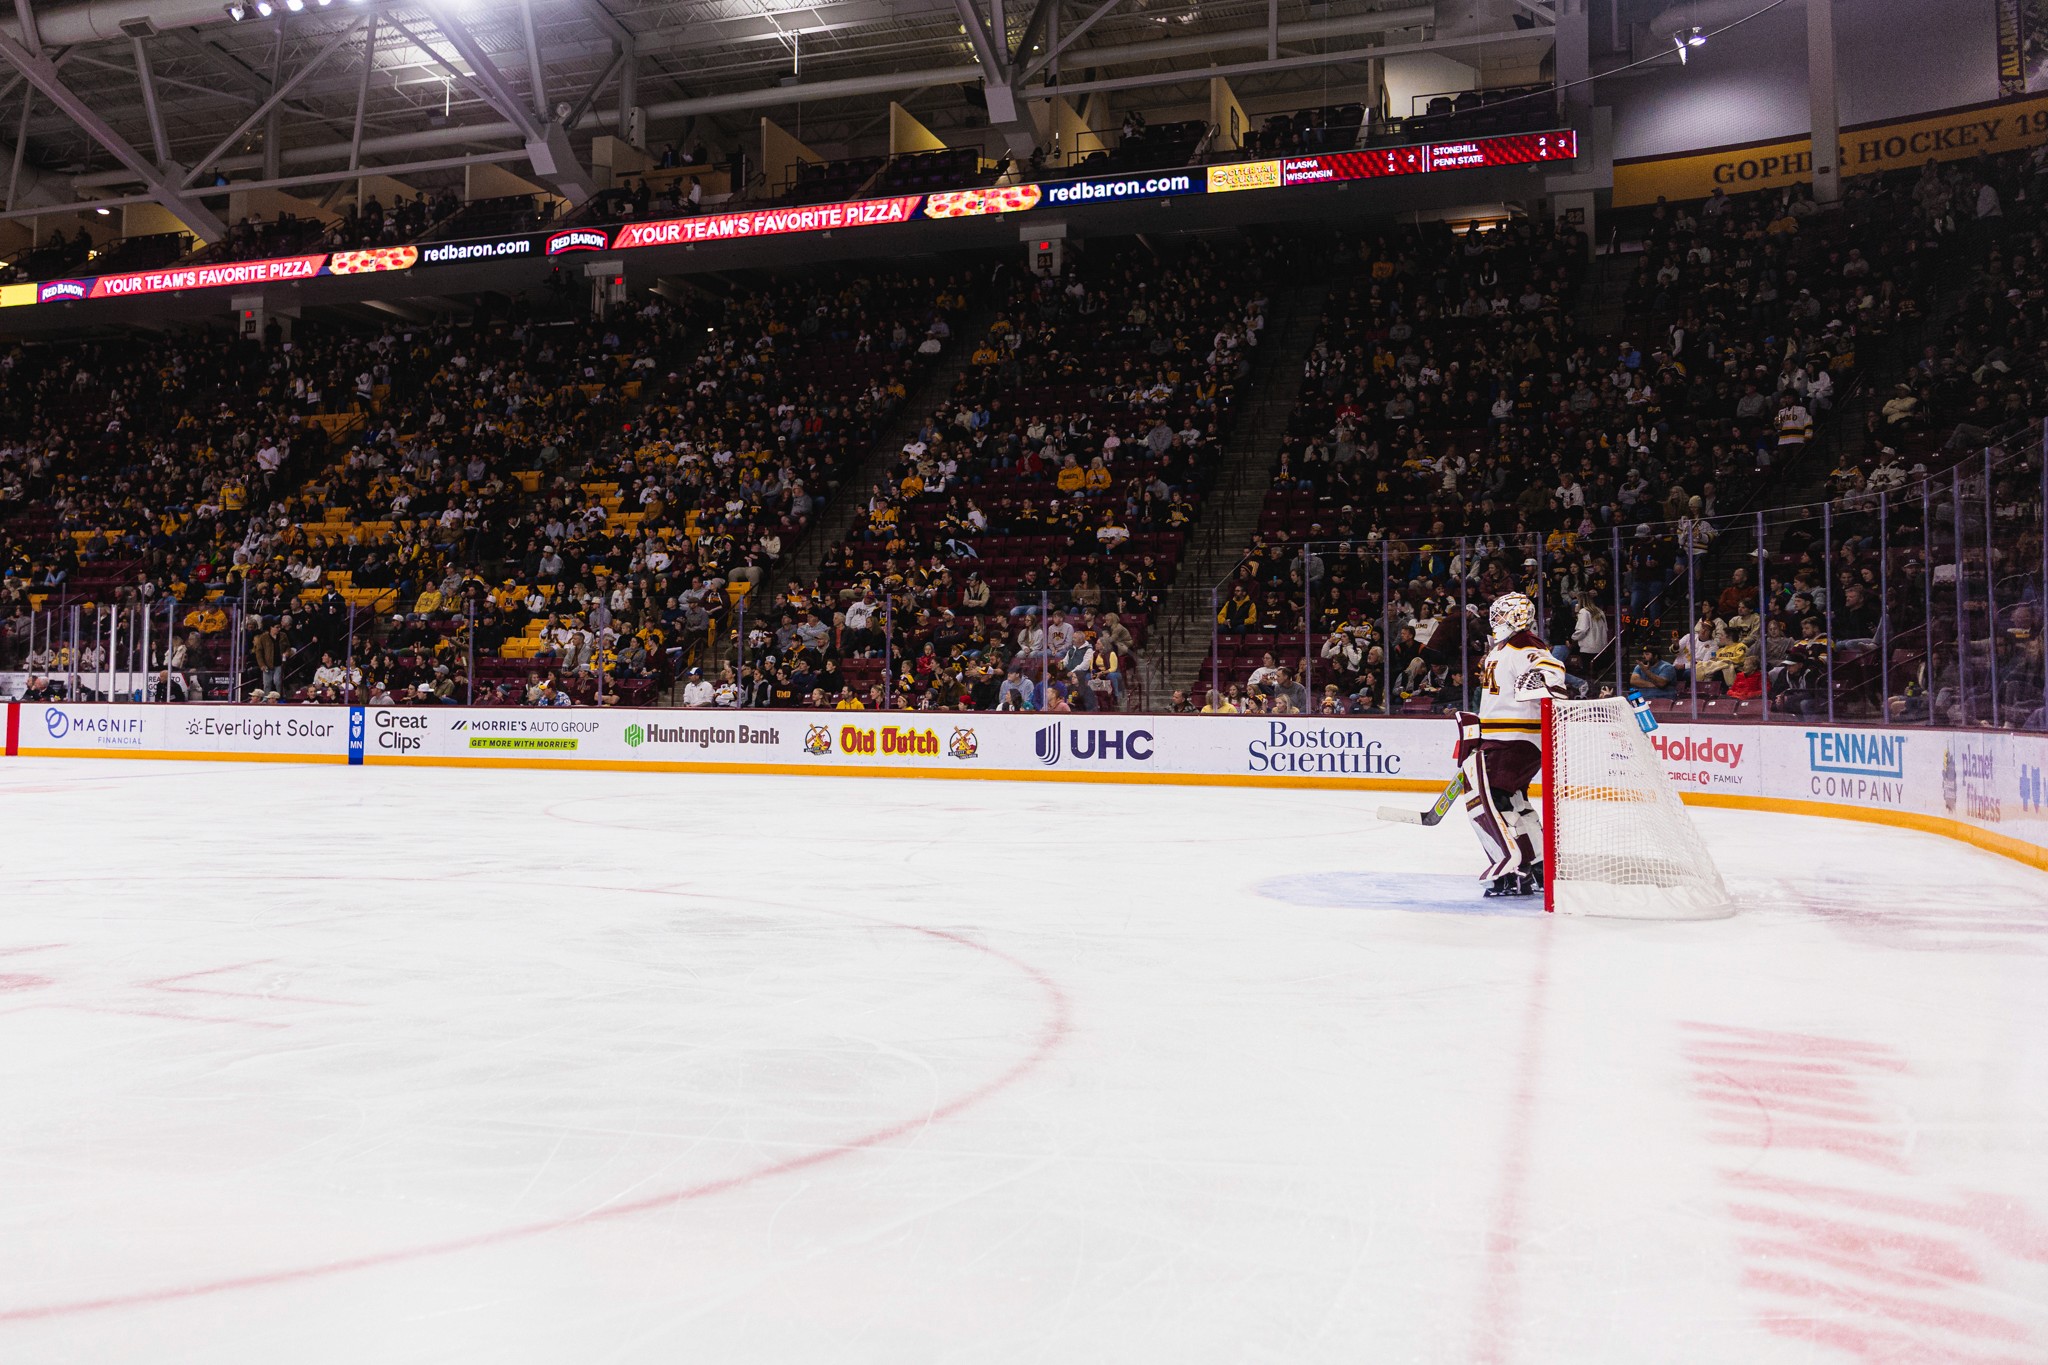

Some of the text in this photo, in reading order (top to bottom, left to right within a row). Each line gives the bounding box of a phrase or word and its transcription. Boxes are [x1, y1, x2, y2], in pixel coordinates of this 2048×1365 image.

[1433, 137, 1565, 155] STONEHILL 2 3
[1857, 117, 2004, 164] HOCKEY
[1286, 152, 1415, 170] ALASKA 1 2
[1433, 149, 1546, 167] PENN STATE 4
[1286, 164, 1395, 180] WISCONSIN 1
[1049, 175, 1190, 202] redbaron.com
[631, 203, 903, 245] YOUR TEAM'S FAVORITE PIZZA
[424, 240, 530, 262] redbaron.com
[551, 233, 605, 252] RED BARON
[1038, 256, 1052, 266] 21
[104, 261, 313, 294] YOUR TEAM'S FAVORITE PIZZA
[42, 283, 84, 300] RED BARON
[776, 689, 791, 698] UMD
[73, 718, 143, 733] MAGNIFI
[204, 718, 334, 740] Everlight Solar
[375, 710, 428, 729] Great
[472, 720, 600, 733] MORRIE'S AUTO GROUP
[97, 737, 142, 745] FINANCIAL
[350, 740, 363, 749] MN
[378, 731, 421, 754] Clips
[472, 739, 576, 749] GET MORE WITH MORRIE'S
[647, 723, 780, 749] Huntington Bank
[841, 725, 939, 755] Old Dutch
[1070, 729, 1154, 760] UHC
[1268, 721, 1365, 750] Boston
[1248, 739, 1401, 775] Scientific
[1650, 735, 1744, 768] Holiday
[1805, 731, 1905, 768] TENNANT
[1961, 743, 1994, 787] planet
[1713, 774, 1743, 784] FAMILY
[1811, 775, 1904, 804] COMPANY
[1967, 782, 2001, 823] fitness
